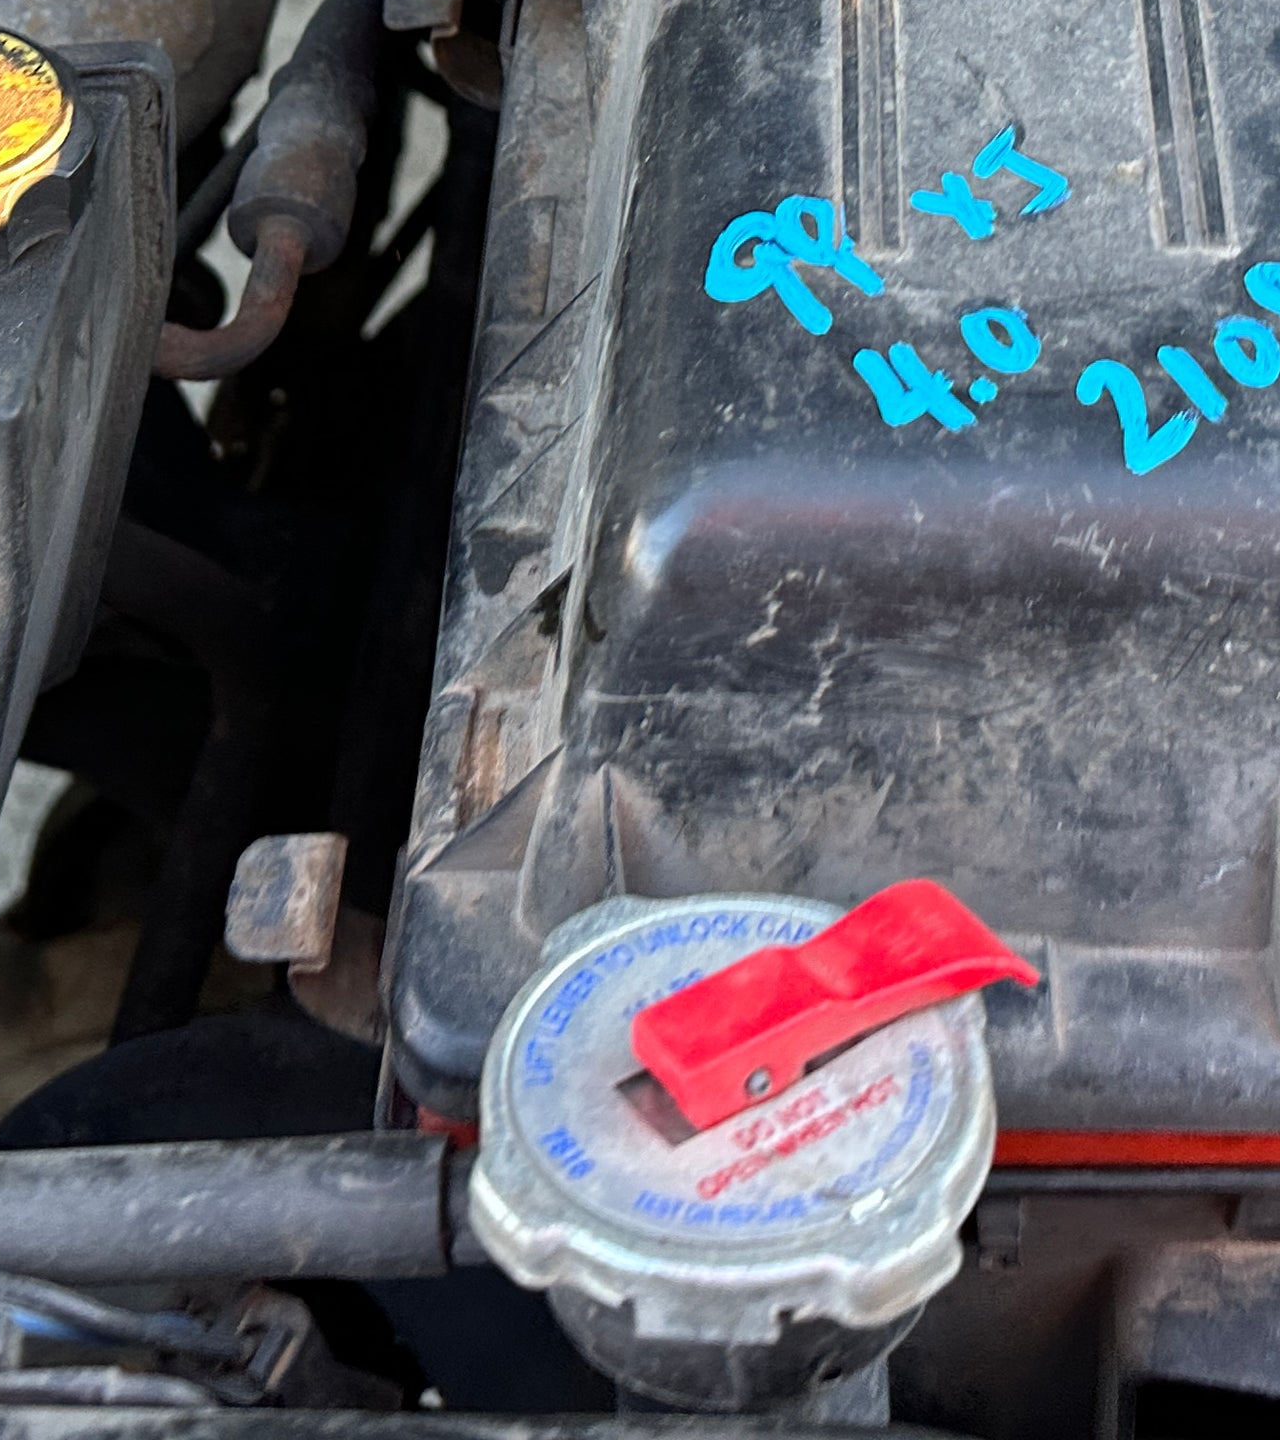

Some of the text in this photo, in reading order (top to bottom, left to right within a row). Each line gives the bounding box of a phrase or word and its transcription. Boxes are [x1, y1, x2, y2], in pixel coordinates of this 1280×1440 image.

[910, 124, 1072, 240] XJ
[853, 306, 1042, 433] 4.0
[593, 943, 634, 973] TO
[634, 915, 750, 955] UNLOCK
[695, 1152, 774, 1202] OPEN
[851, 1072, 901, 1113] HOT
[733, 1088, 830, 1152] DO NOT
